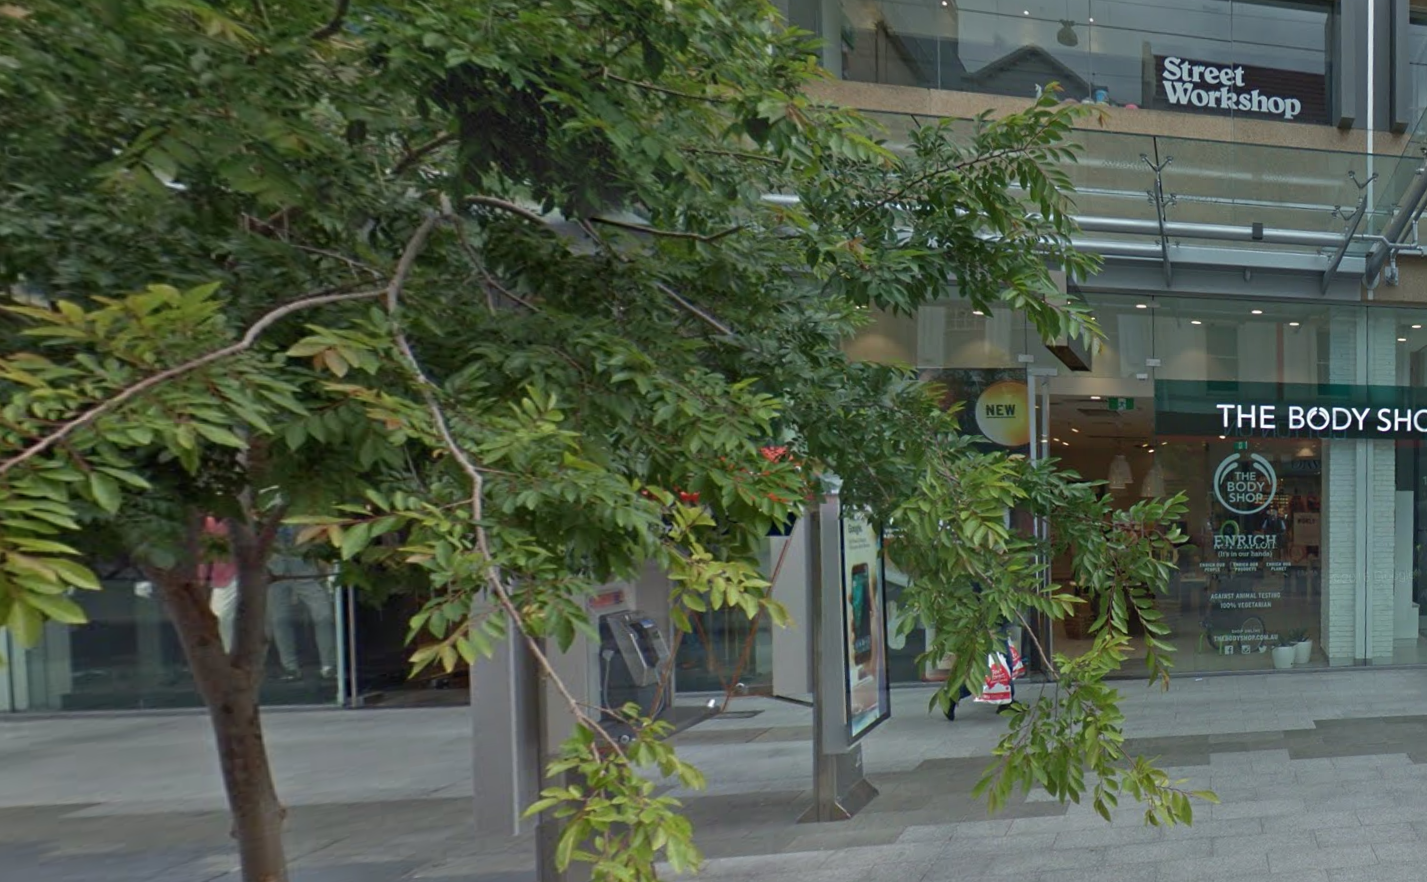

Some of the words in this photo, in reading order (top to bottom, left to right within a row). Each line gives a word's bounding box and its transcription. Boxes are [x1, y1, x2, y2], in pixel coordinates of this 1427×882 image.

[1162, 56, 1246, 87] Street
[1162, 80, 1302, 120] Workshop
[985, 404, 1016, 416] NEW
[1216, 404, 1276, 429] THE
[1288, 406, 1371, 431] BODY
[1235, 472, 1256, 481] THE
[1227, 481, 1265, 492] BODY
[1229, 492, 1264, 503] SHOP
[1213, 534, 1277, 547] ENRICH
